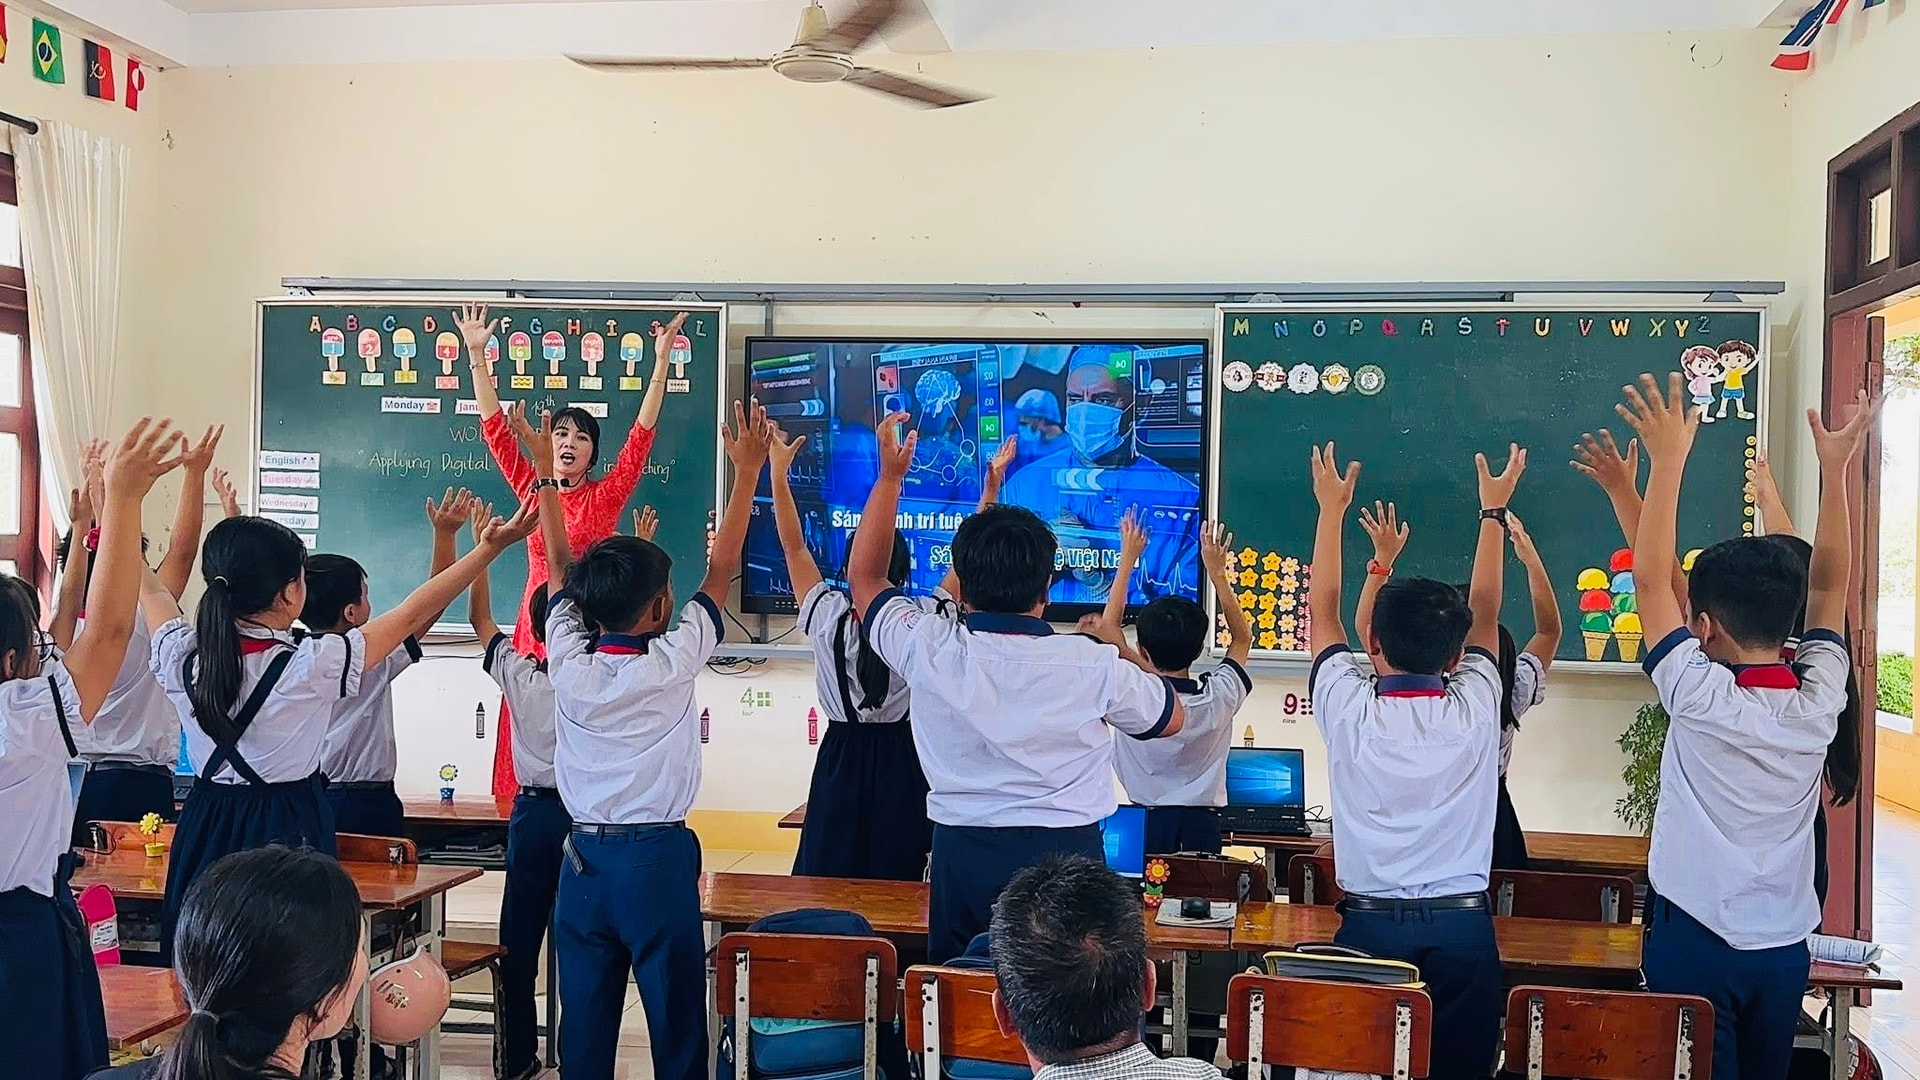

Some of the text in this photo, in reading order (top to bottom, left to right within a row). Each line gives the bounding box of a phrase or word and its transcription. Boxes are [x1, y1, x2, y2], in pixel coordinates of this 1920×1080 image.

[309, 316, 322, 332] A
[346, 315, 359, 331] B
[382, 316, 396, 332] C
[424, 316, 436, 332] D
[500, 316, 512, 334] F
[530, 318, 542, 334] G
[567, 318, 580, 336] H
[606, 319, 618, 336] I
[696, 320, 707, 337] L
[1232, 318, 1250, 336] M
[1274, 320, 1288, 338] N
[1313, 320, 1326, 337] O
[1350, 319, 1364, 336] P
[1382, 319, 1400, 336] Q
[1458, 316, 1472, 335] S
[1496, 318, 1510, 336] T
[1534, 318, 1550, 336] U
[1579, 318, 1594, 336] V
[1610, 318, 1630, 337] W
[1649, 318, 1666, 337] X
[1674, 320, 1690, 338] Y
[1698, 316, 1710, 334] Z
[367, 345, 374, 354] 2
[401, 346, 408, 355] 3
[443, 346, 450, 357] 4
[484, 348, 492, 359] 5
[516, 348, 524, 358] 6
[628, 348, 636, 359] 9
[676, 350, 685, 360] 10
[384, 400, 424, 412] Monday
[266, 456, 300, 466] English
[441, 452, 490, 478] Digital
[642, 456, 676, 484] ching"
[262, 474, 303, 485] Tuesday
[262, 499, 308, 508] Wednesday
[832, 510, 862, 528] Sán
[918, 512, 935, 530] trí
[1067, 548, 1100, 572] Việt
[1102, 548, 1140, 569] Na
[740, 686, 755, 708] 4
[1283, 693, 1298, 715] 9
